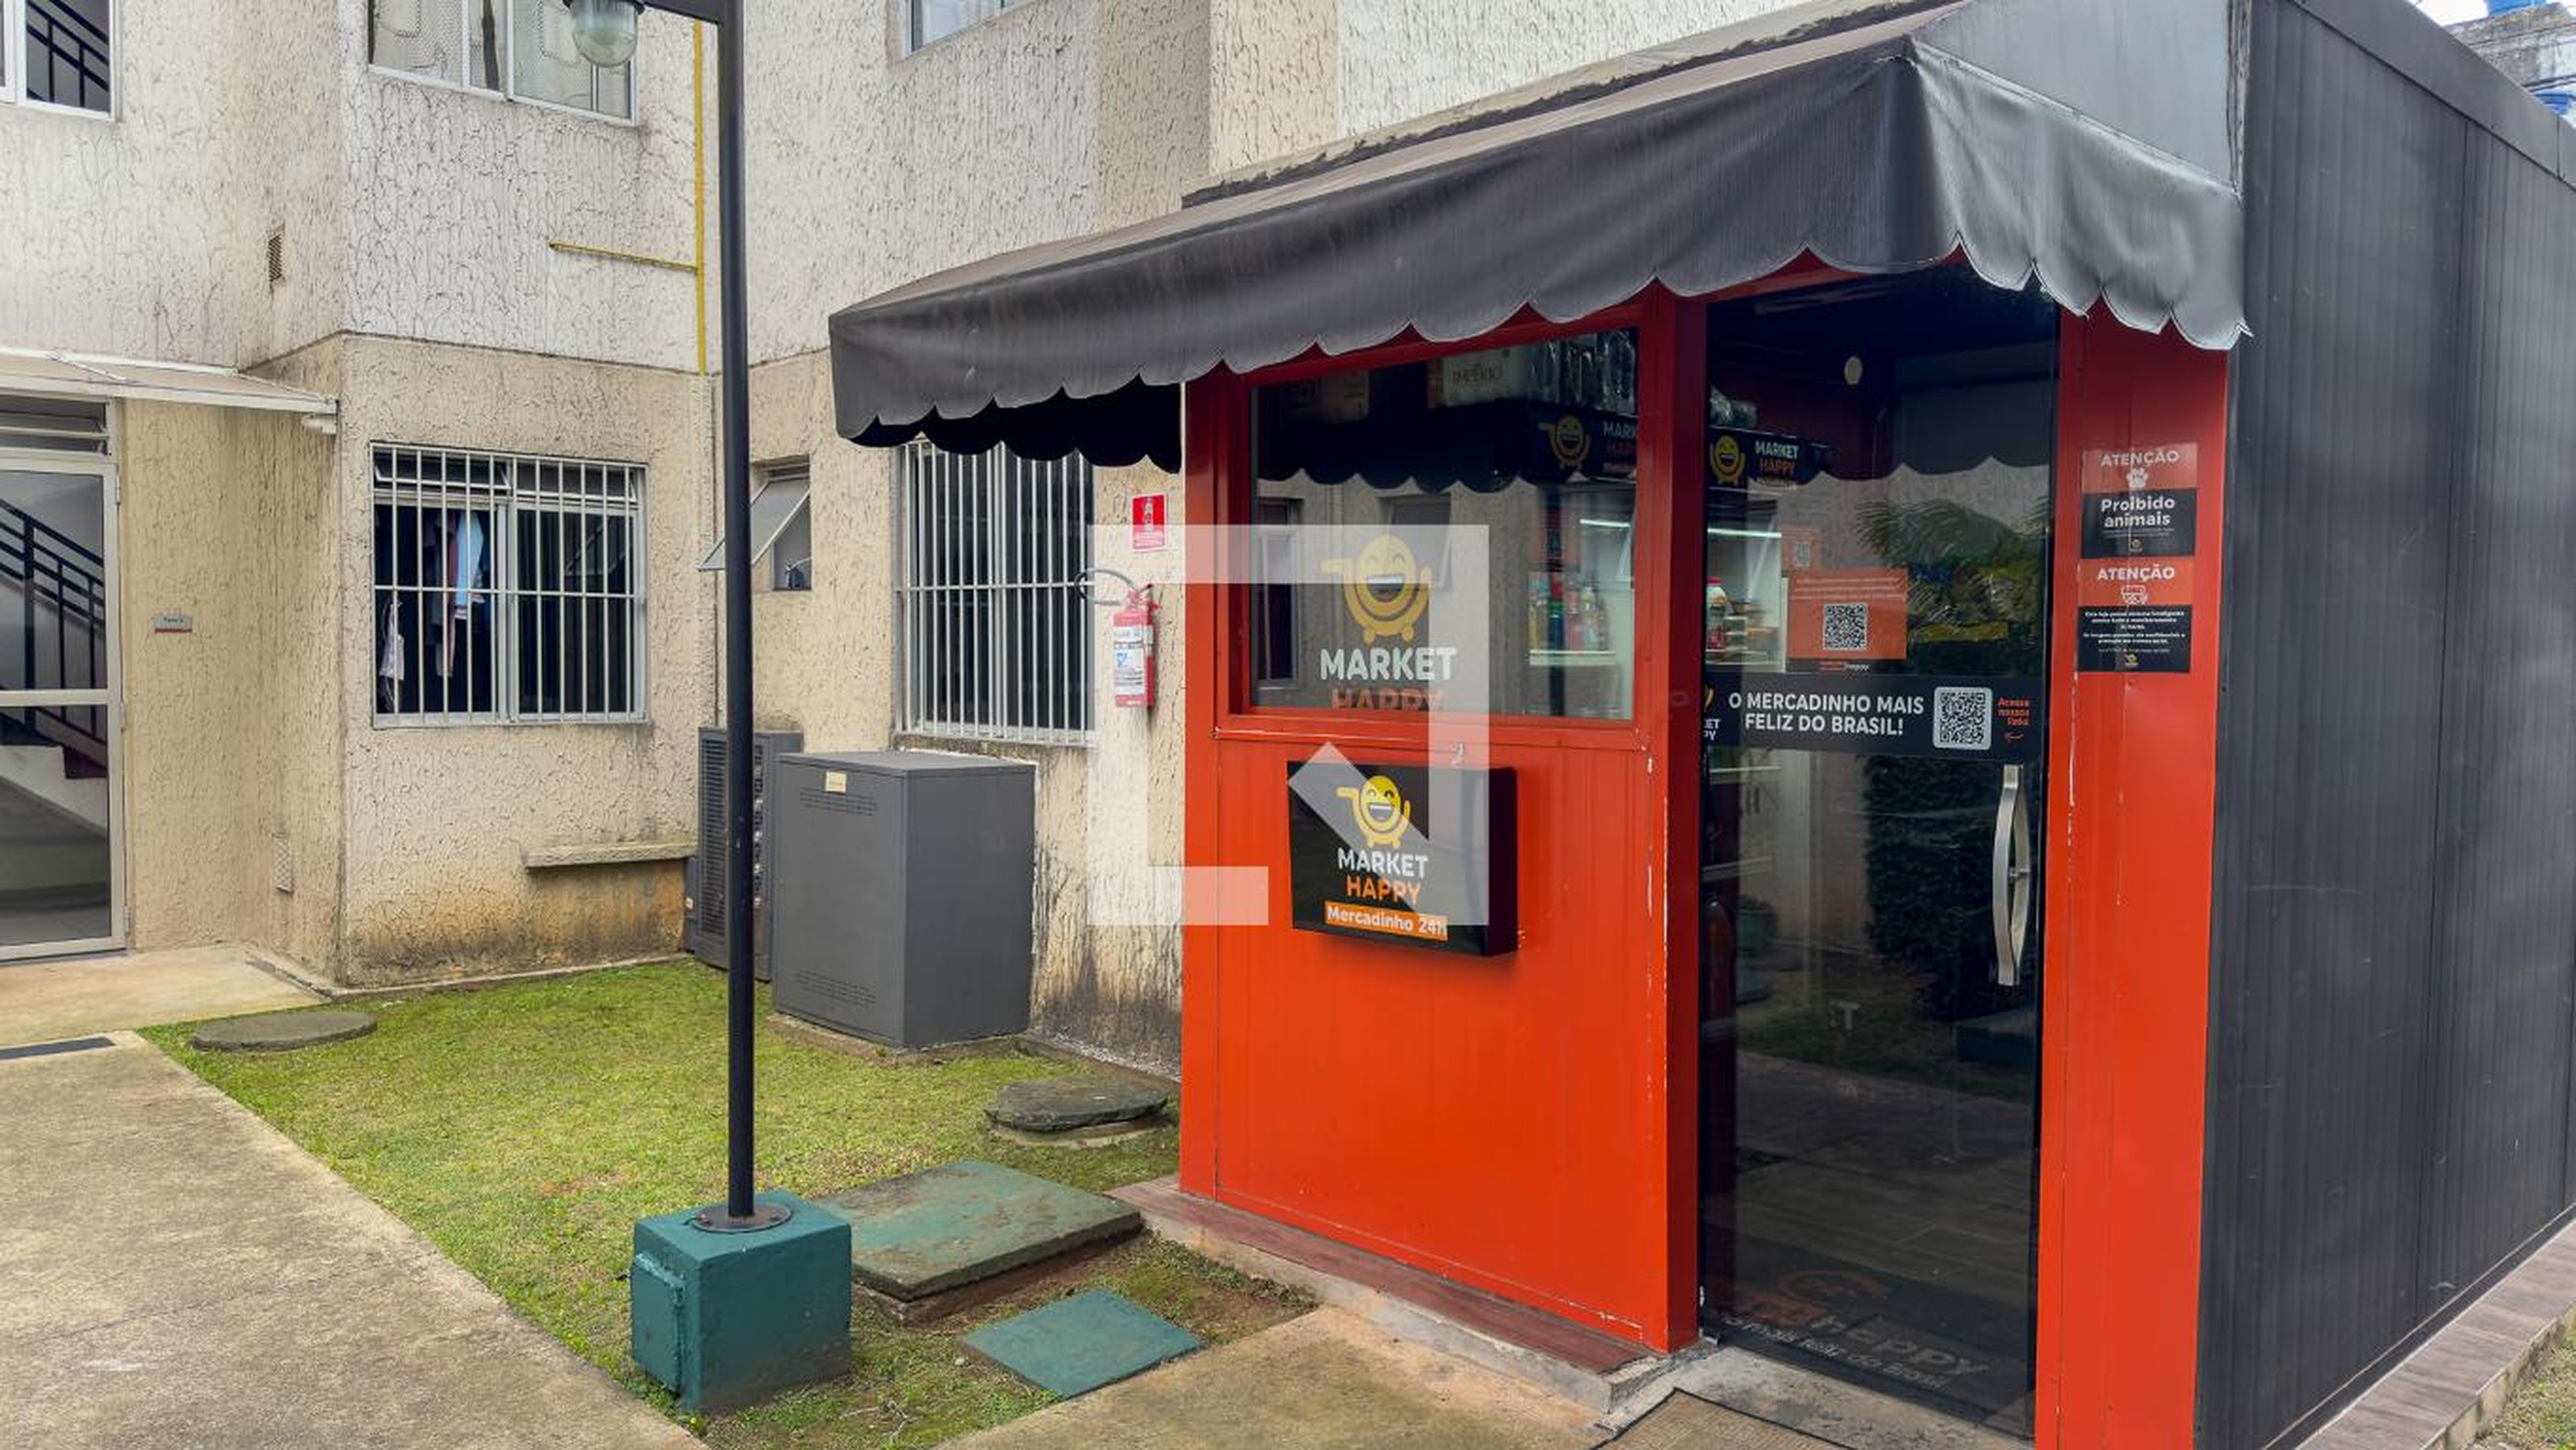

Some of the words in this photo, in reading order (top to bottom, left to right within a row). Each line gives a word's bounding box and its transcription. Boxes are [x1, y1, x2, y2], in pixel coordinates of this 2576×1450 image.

[1755, 440, 1799, 460] MARKET
[2101, 495, 2176, 513] Proibido
[2104, 511, 2171, 528] animais
[2098, 564, 2176, 582] ATENÇÃO
[1320, 648, 1458, 680] MARKET
[1729, 692, 1741, 709] O
[1747, 692, 1870, 713] MERCADINHO
[1877, 696, 1924, 715] MAIS
[1746, 713, 1793, 731] FELIZ
[1799, 715, 1826, 732] DO
[1831, 715, 1903, 736] BRASIL!
[1338, 847, 1429, 878] MARKET
[1346, 874, 1421, 905] HAPPY
[1328, 905, 1413, 931] Mercadinho
[1417, 917, 1448, 937] 24h
